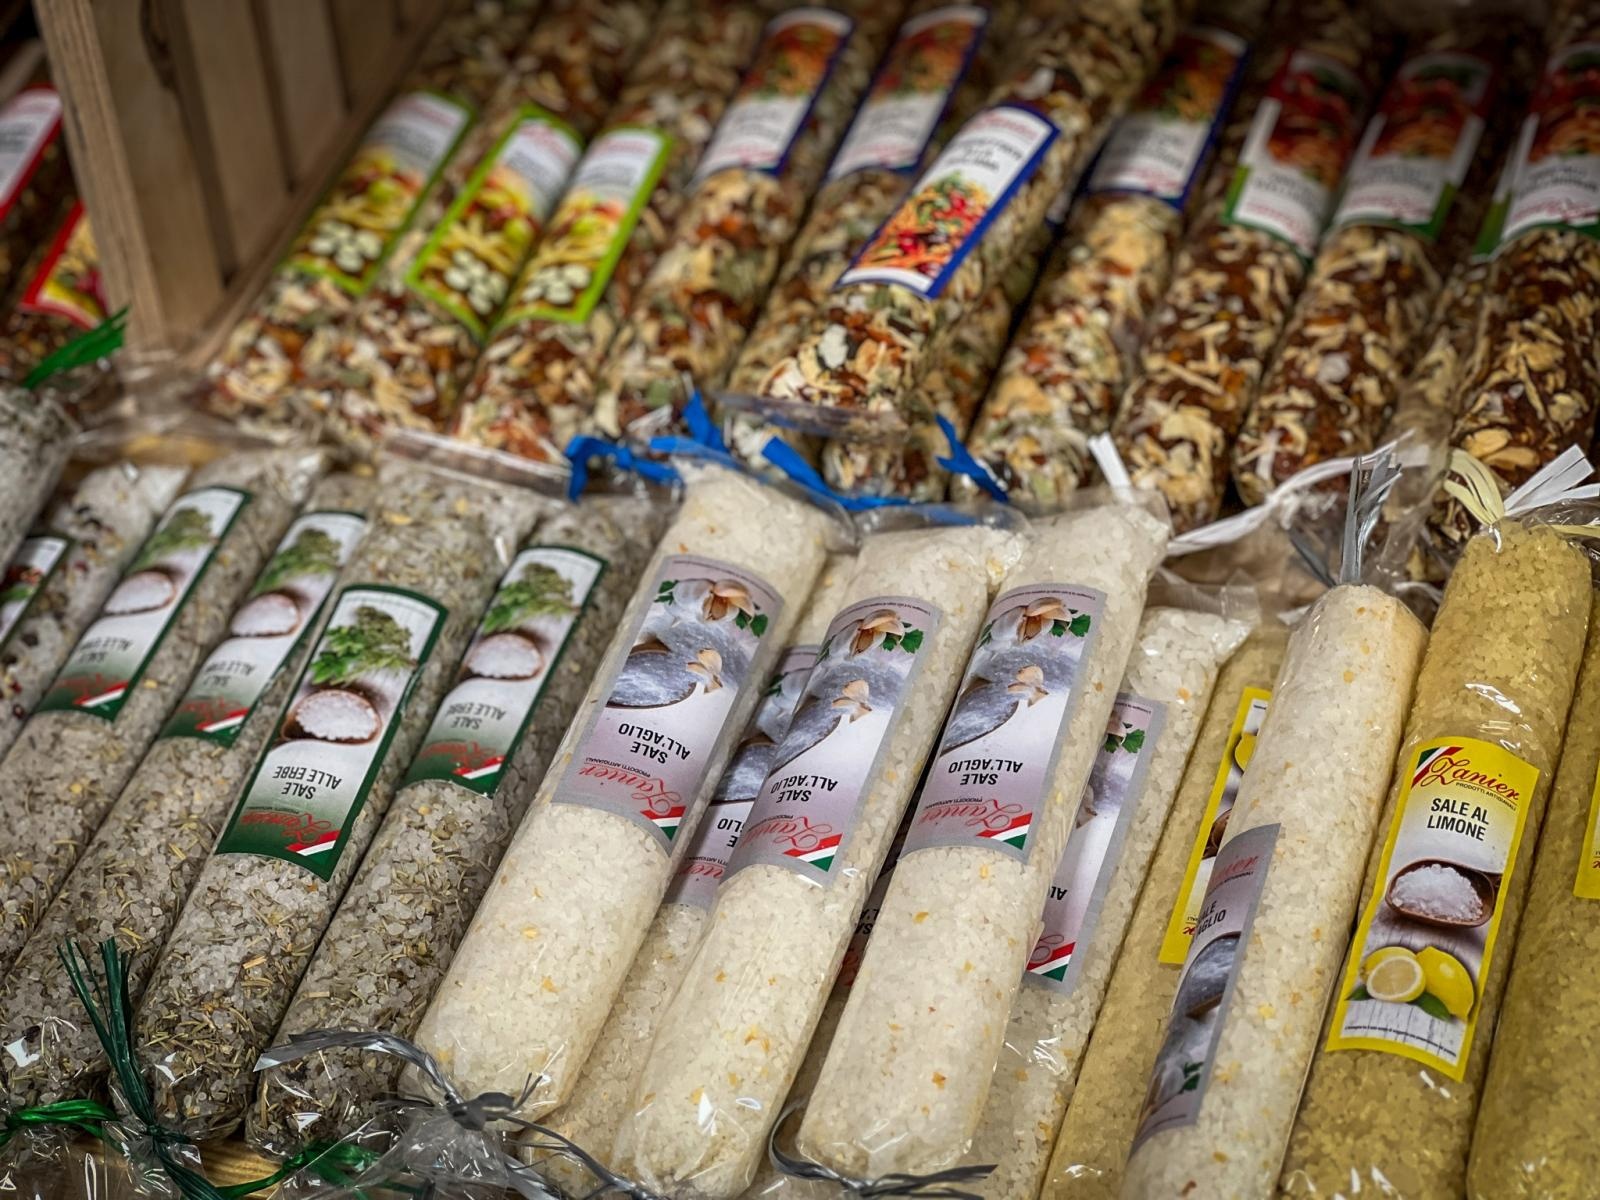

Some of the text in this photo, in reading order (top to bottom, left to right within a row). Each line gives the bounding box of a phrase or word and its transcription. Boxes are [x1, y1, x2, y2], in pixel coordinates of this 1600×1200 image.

[473, 703, 506, 721] ALLE
[451, 717, 482, 730] SALE
[618, 723, 691, 760] ALL'AGLIO
[630, 741, 668, 764] SALE
[948, 759, 1024, 774] ALL'AGLIO
[272, 766, 342, 790] ALLE ERBE
[770, 775, 838, 794] ALL'AGLIO
[960, 773, 999, 786] SALE
[1420, 757, 1520, 801] Zanier
[281, 782, 316, 800] SALE
[578, 766, 682, 816] Zanier
[776, 790, 812, 804] SALE
[1431, 798, 1490, 825] SALE AL
[1427, 815, 1487, 841] LIMONE
